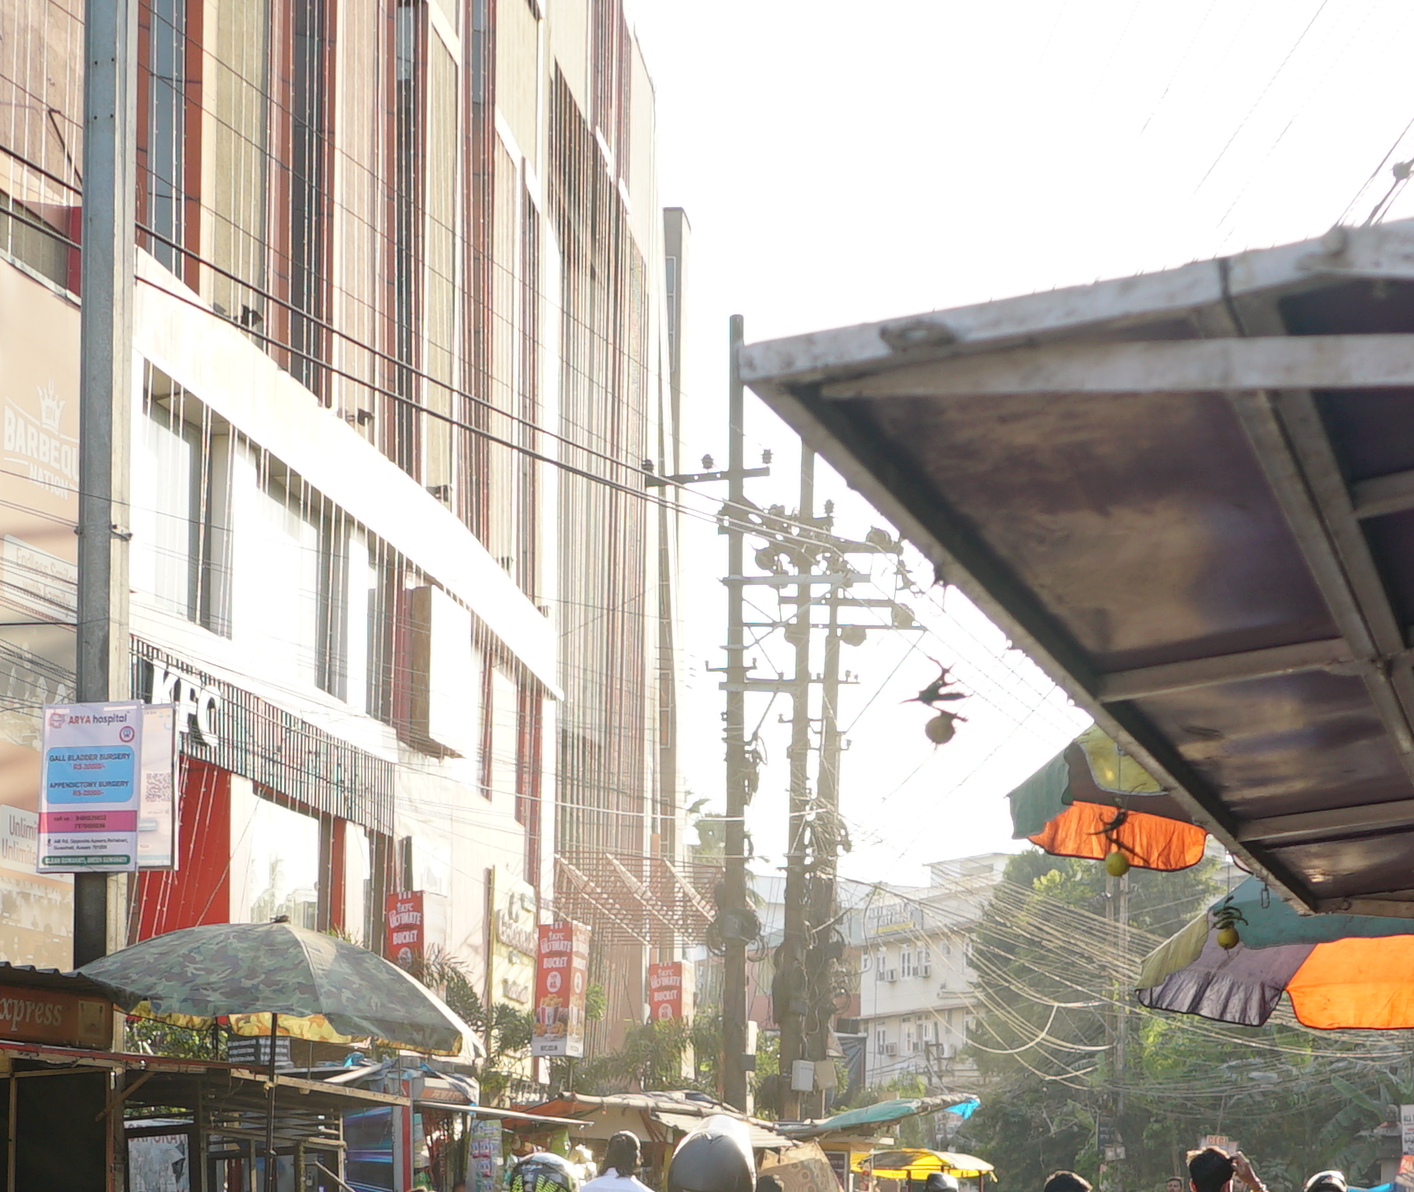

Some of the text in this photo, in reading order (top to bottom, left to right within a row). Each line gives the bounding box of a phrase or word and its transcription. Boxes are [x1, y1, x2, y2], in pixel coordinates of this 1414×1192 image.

[3, 404, 79, 483] BARBEQU
[28, 461, 70, 500] NATION
[68, 713, 127, 726] ARYA hospital
[100, 752, 131, 760] SURGERY
[1, 838, 38, 861] Unlimite
[392, 930, 418, 945] BUCKET
[543, 956, 568, 969] BUCKET
